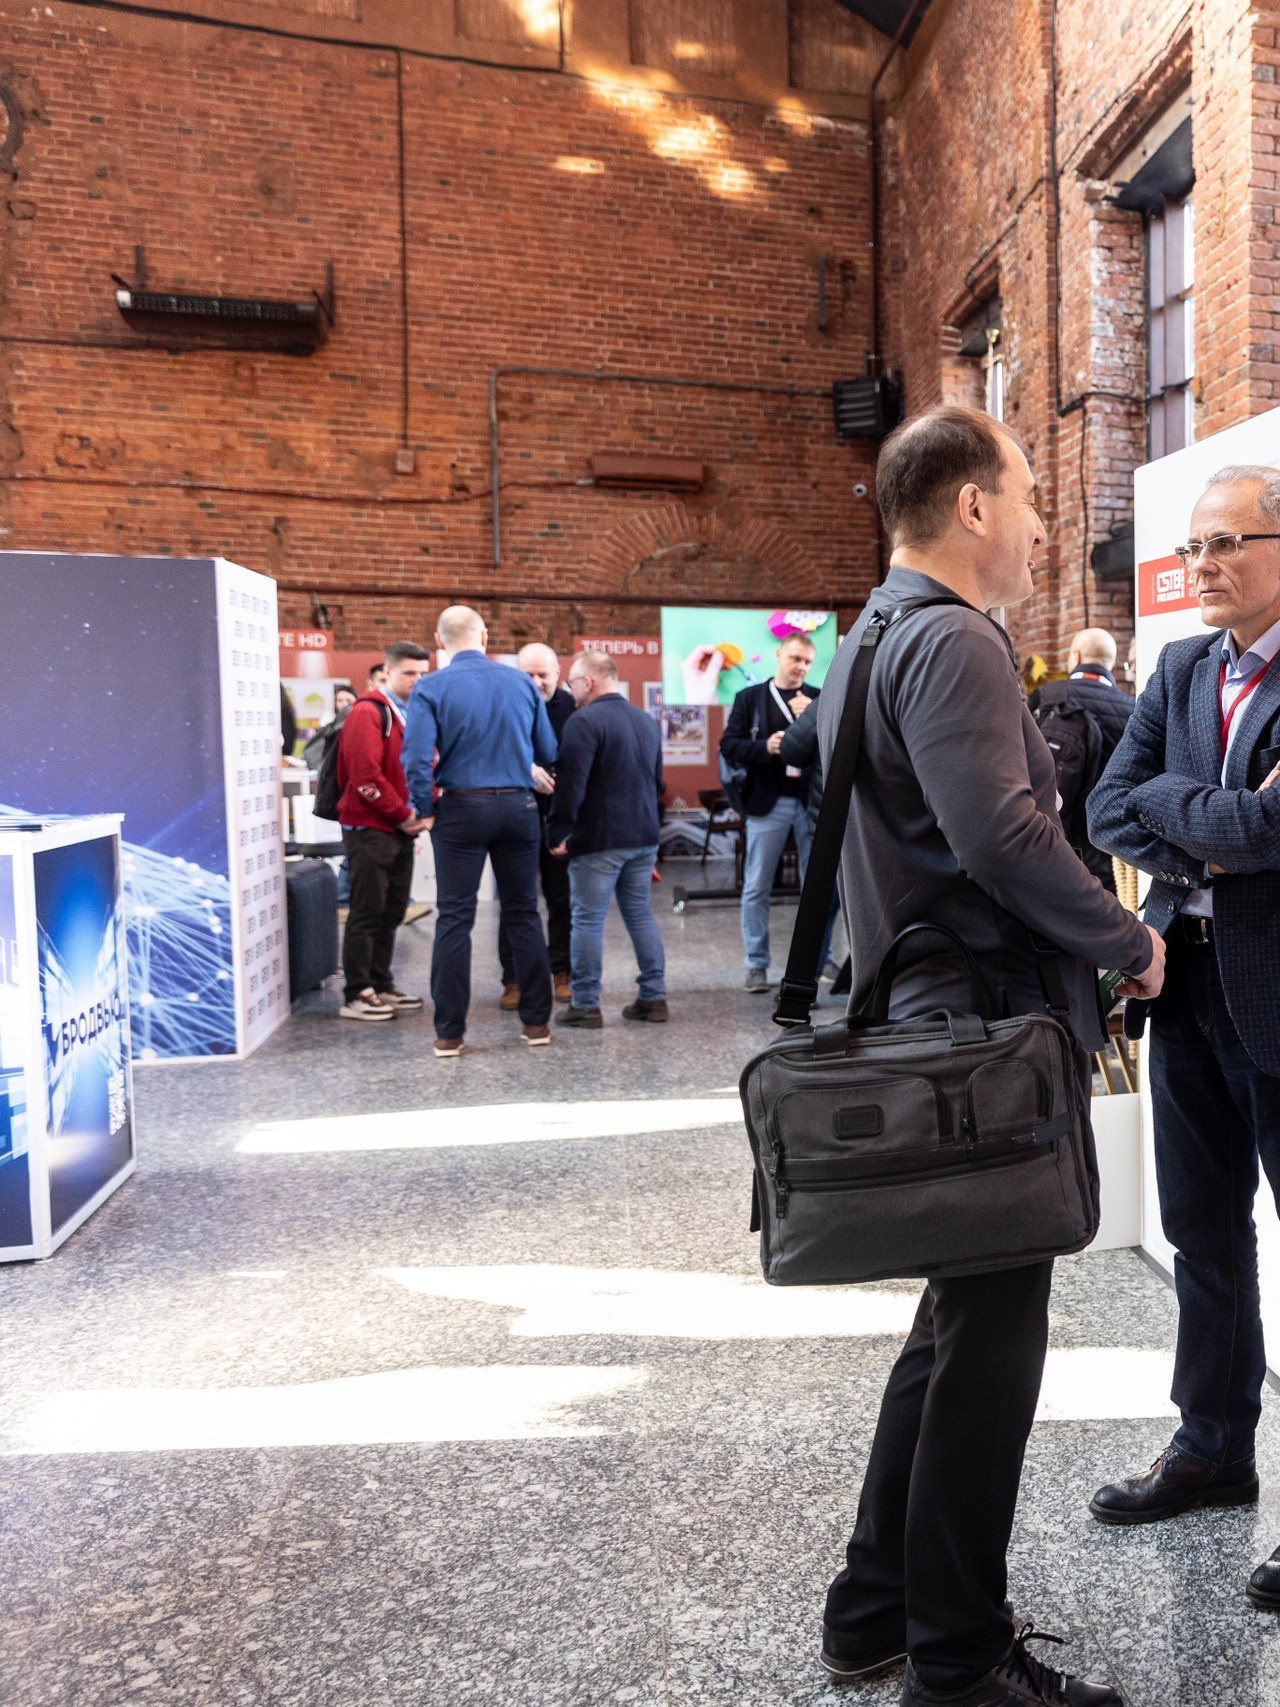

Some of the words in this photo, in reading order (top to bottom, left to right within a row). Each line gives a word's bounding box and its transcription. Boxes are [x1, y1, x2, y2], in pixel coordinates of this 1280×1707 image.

[300, 633, 328, 648] HD
[581, 639, 644, 655] ТЕПЕРЬ
[62, 993, 122, 1057] БРОДВЬЮ
